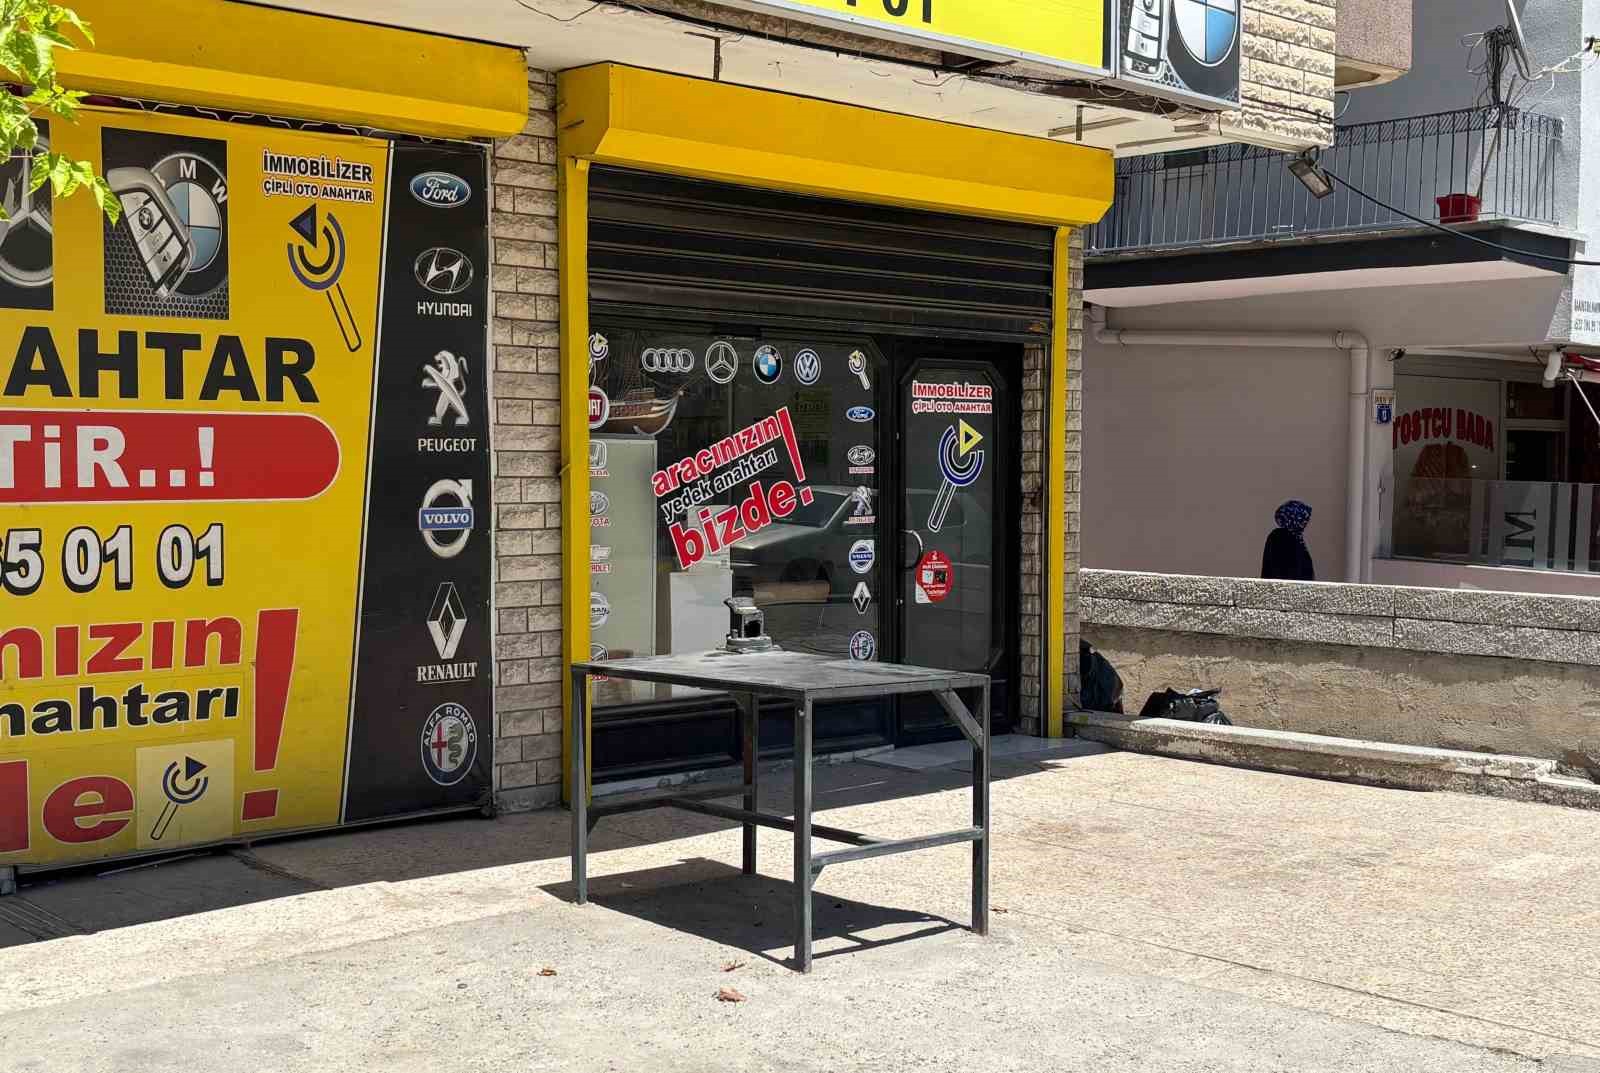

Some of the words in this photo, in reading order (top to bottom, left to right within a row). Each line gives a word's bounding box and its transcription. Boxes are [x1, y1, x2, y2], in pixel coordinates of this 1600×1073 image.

[262, 149, 374, 183] İMMOBİLİZER
[262, 180, 294, 196] ÇİPLİ
[295, 183, 319, 197] OTO
[320, 186, 374, 202] ANAHTAR
[422, 176, 460, 202] Ford
[416, 301, 473, 317] HYUNDAI
[912, 380, 993, 400] İMMOBİLİZER
[935, 402, 953, 413] OTO
[953, 402, 993, 414] ANAHTAR
[417, 437, 478, 453] PEUGEOT
[661, 480, 714, 525] yedek
[713, 448, 778, 494] anahtarı
[423, 513, 470, 525] VOLVO
[0, 527, 44, 596] 5
[62, 525, 134, 593] 01
[156, 522, 225, 589] 01
[416, 662, 478, 682] RENAULT
[424, 712, 442, 746] ALFA
[446, 706, 475, 743] ROMEO
